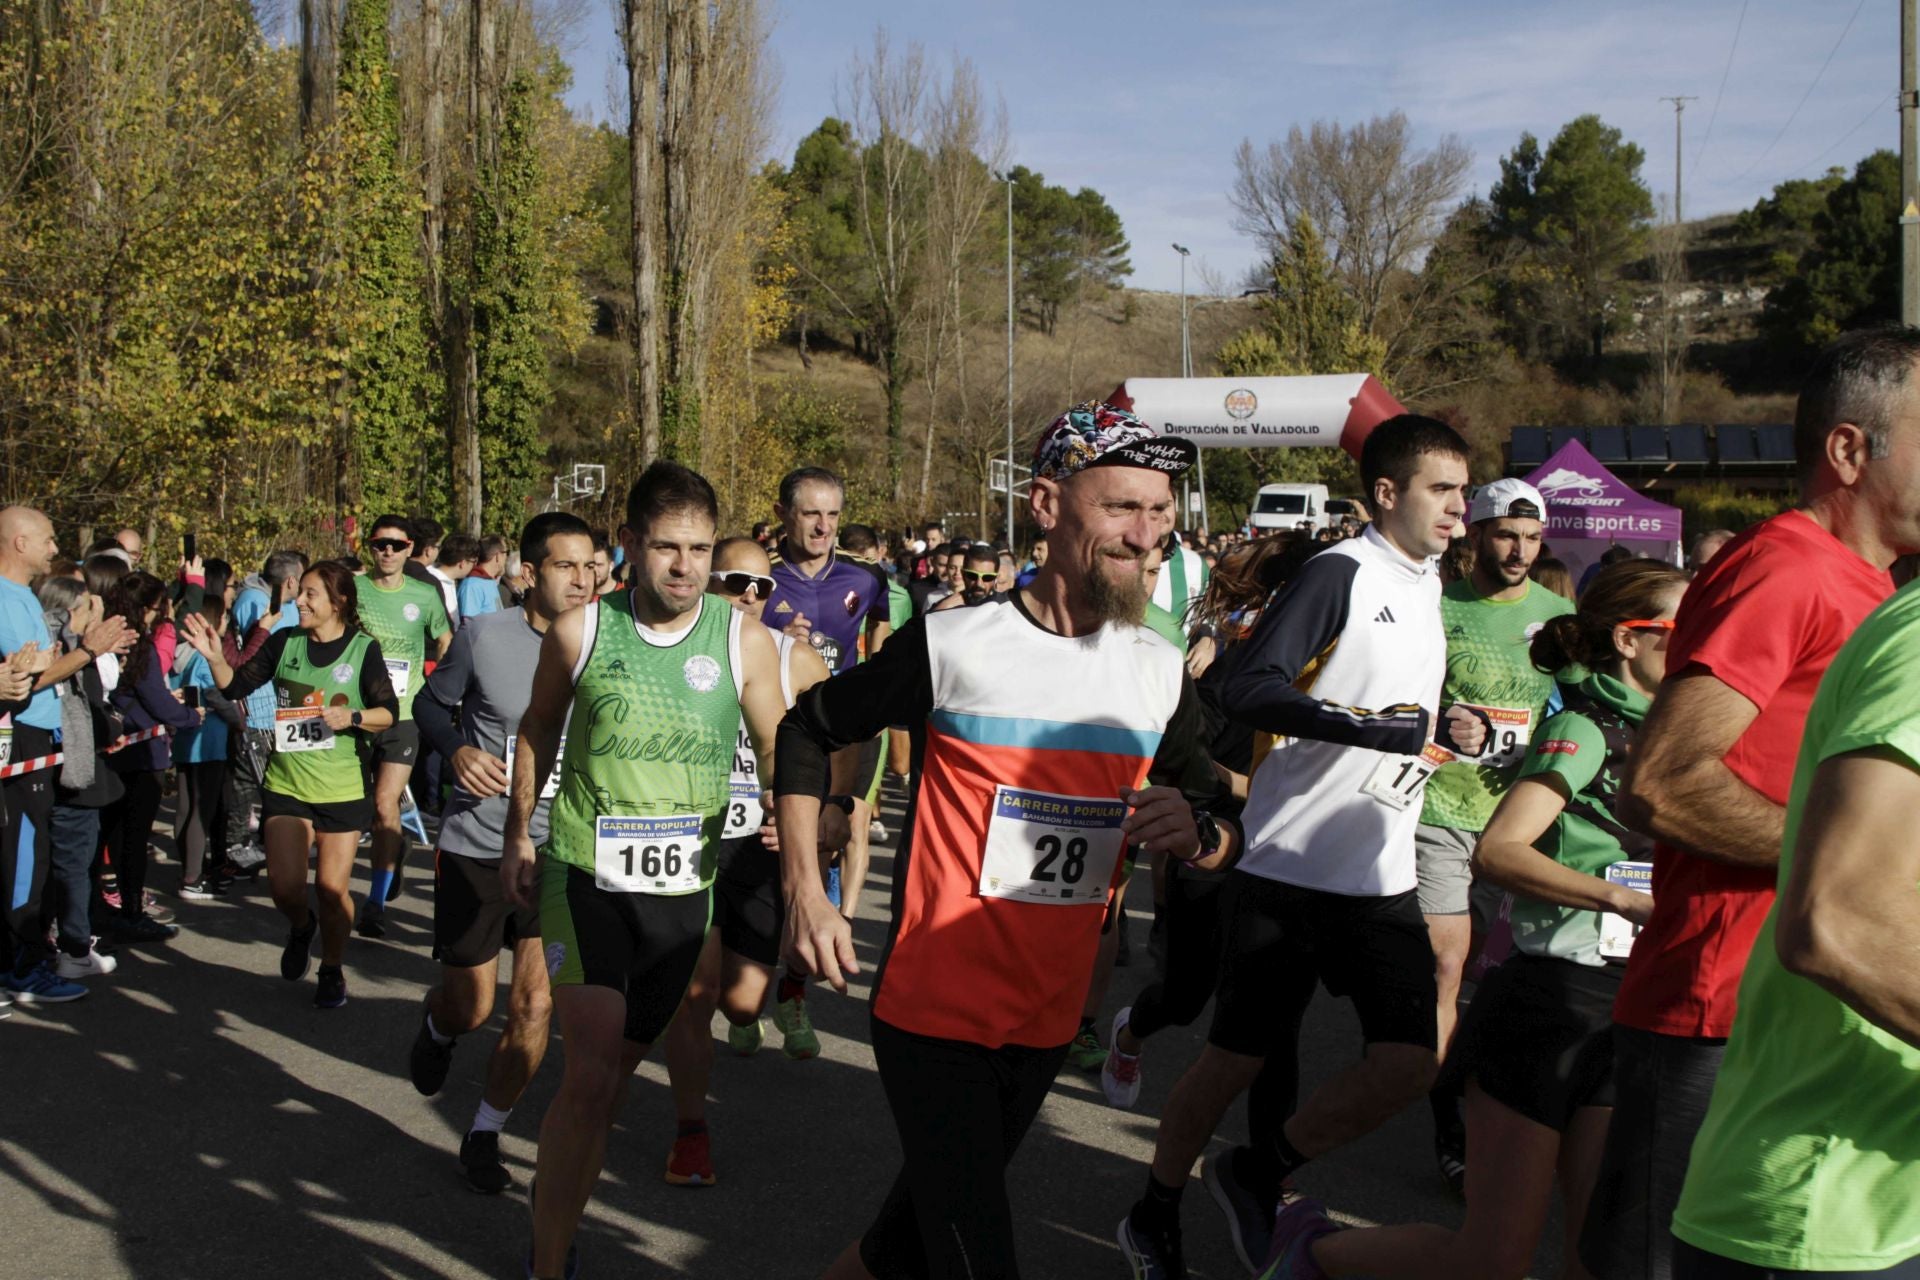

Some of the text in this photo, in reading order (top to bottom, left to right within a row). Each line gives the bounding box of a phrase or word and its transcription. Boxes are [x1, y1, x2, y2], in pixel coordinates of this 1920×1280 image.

[1165, 422, 1320, 434] DIPUTACIÓN DE VALLADOLID
[1120, 449, 1150, 464] THE
[1144, 443, 1185, 459] WHAT
[286, 722, 322, 743] 245
[1003, 795, 1122, 817] CARRERA POPULAR
[602, 820, 698, 831] CARRERA POPULAR
[618, 843, 682, 878] 166
[1029, 834, 1089, 884] 28
